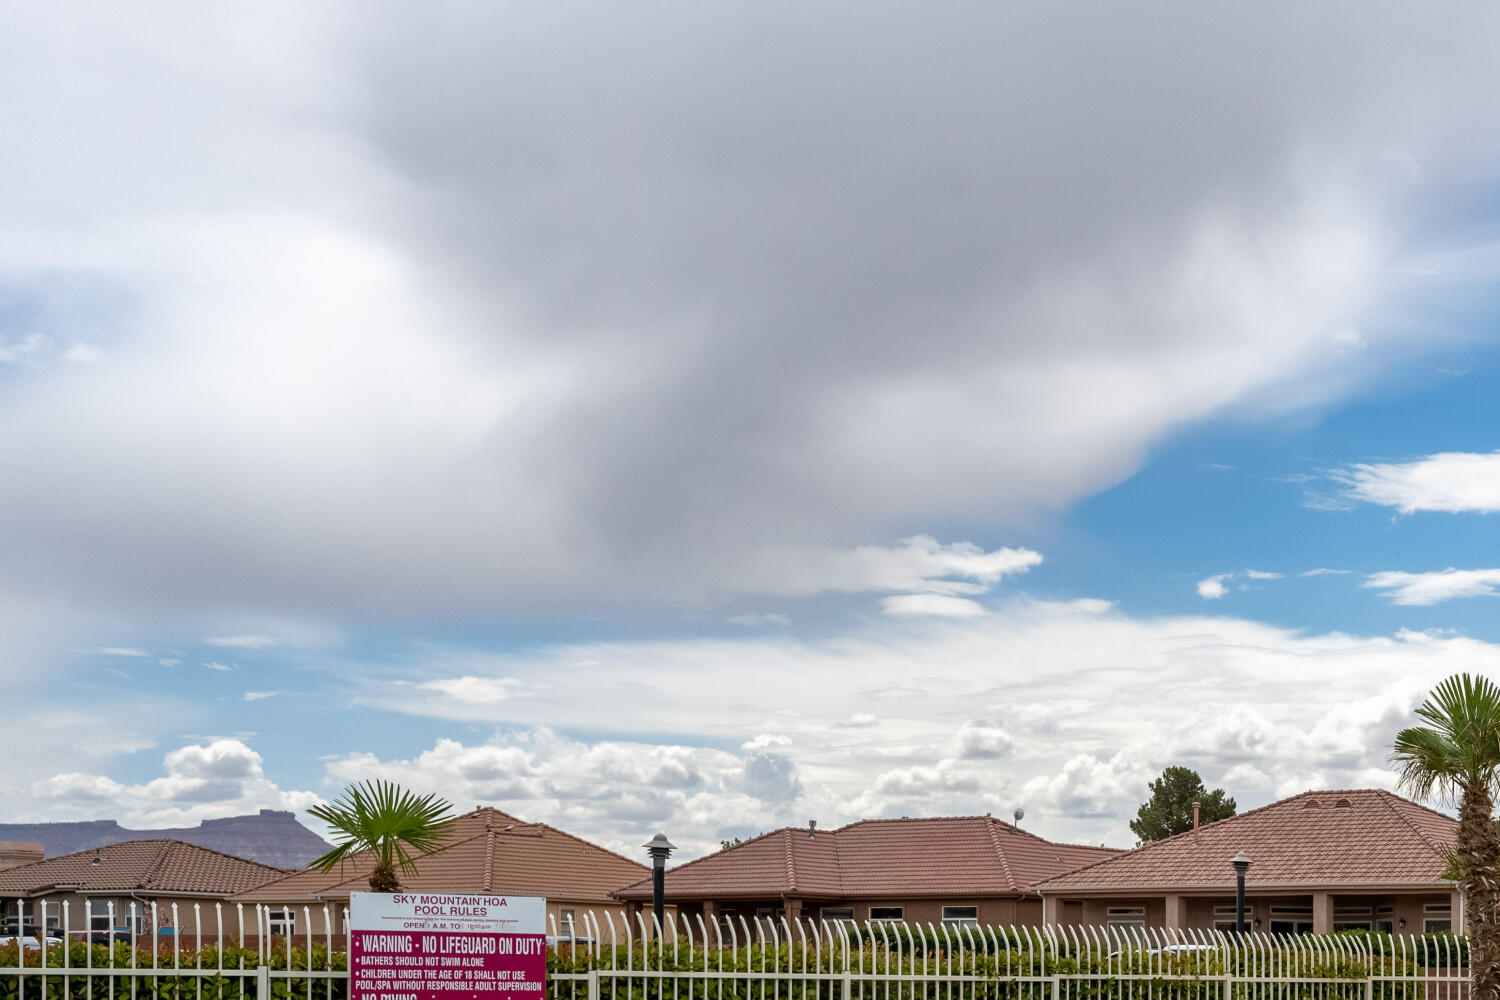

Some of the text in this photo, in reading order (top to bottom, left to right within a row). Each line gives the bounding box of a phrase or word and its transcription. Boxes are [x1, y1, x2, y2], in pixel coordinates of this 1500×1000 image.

[393, 895, 507, 906] SKY MOUNTAIN HOA
[414, 906, 487, 916] POOL RULES
[362, 935, 412, 953] WARNING
[422, 936, 436, 953] NO
[440, 936, 495, 954] LIFEGUARD
[499, 937, 512, 954] ON
[516, 938, 542, 954] DUTY
[361, 956, 484, 966] BATHERS SHOULD NOT SWIM ALONE
[361, 970, 525, 980] CHILDREN UNDER THE AGE OF 18 SHALL NOT USE
[356, 980, 542, 990] POOL/SPA WITHOUT RESPONSIBLE ADULT SUPERVISION
